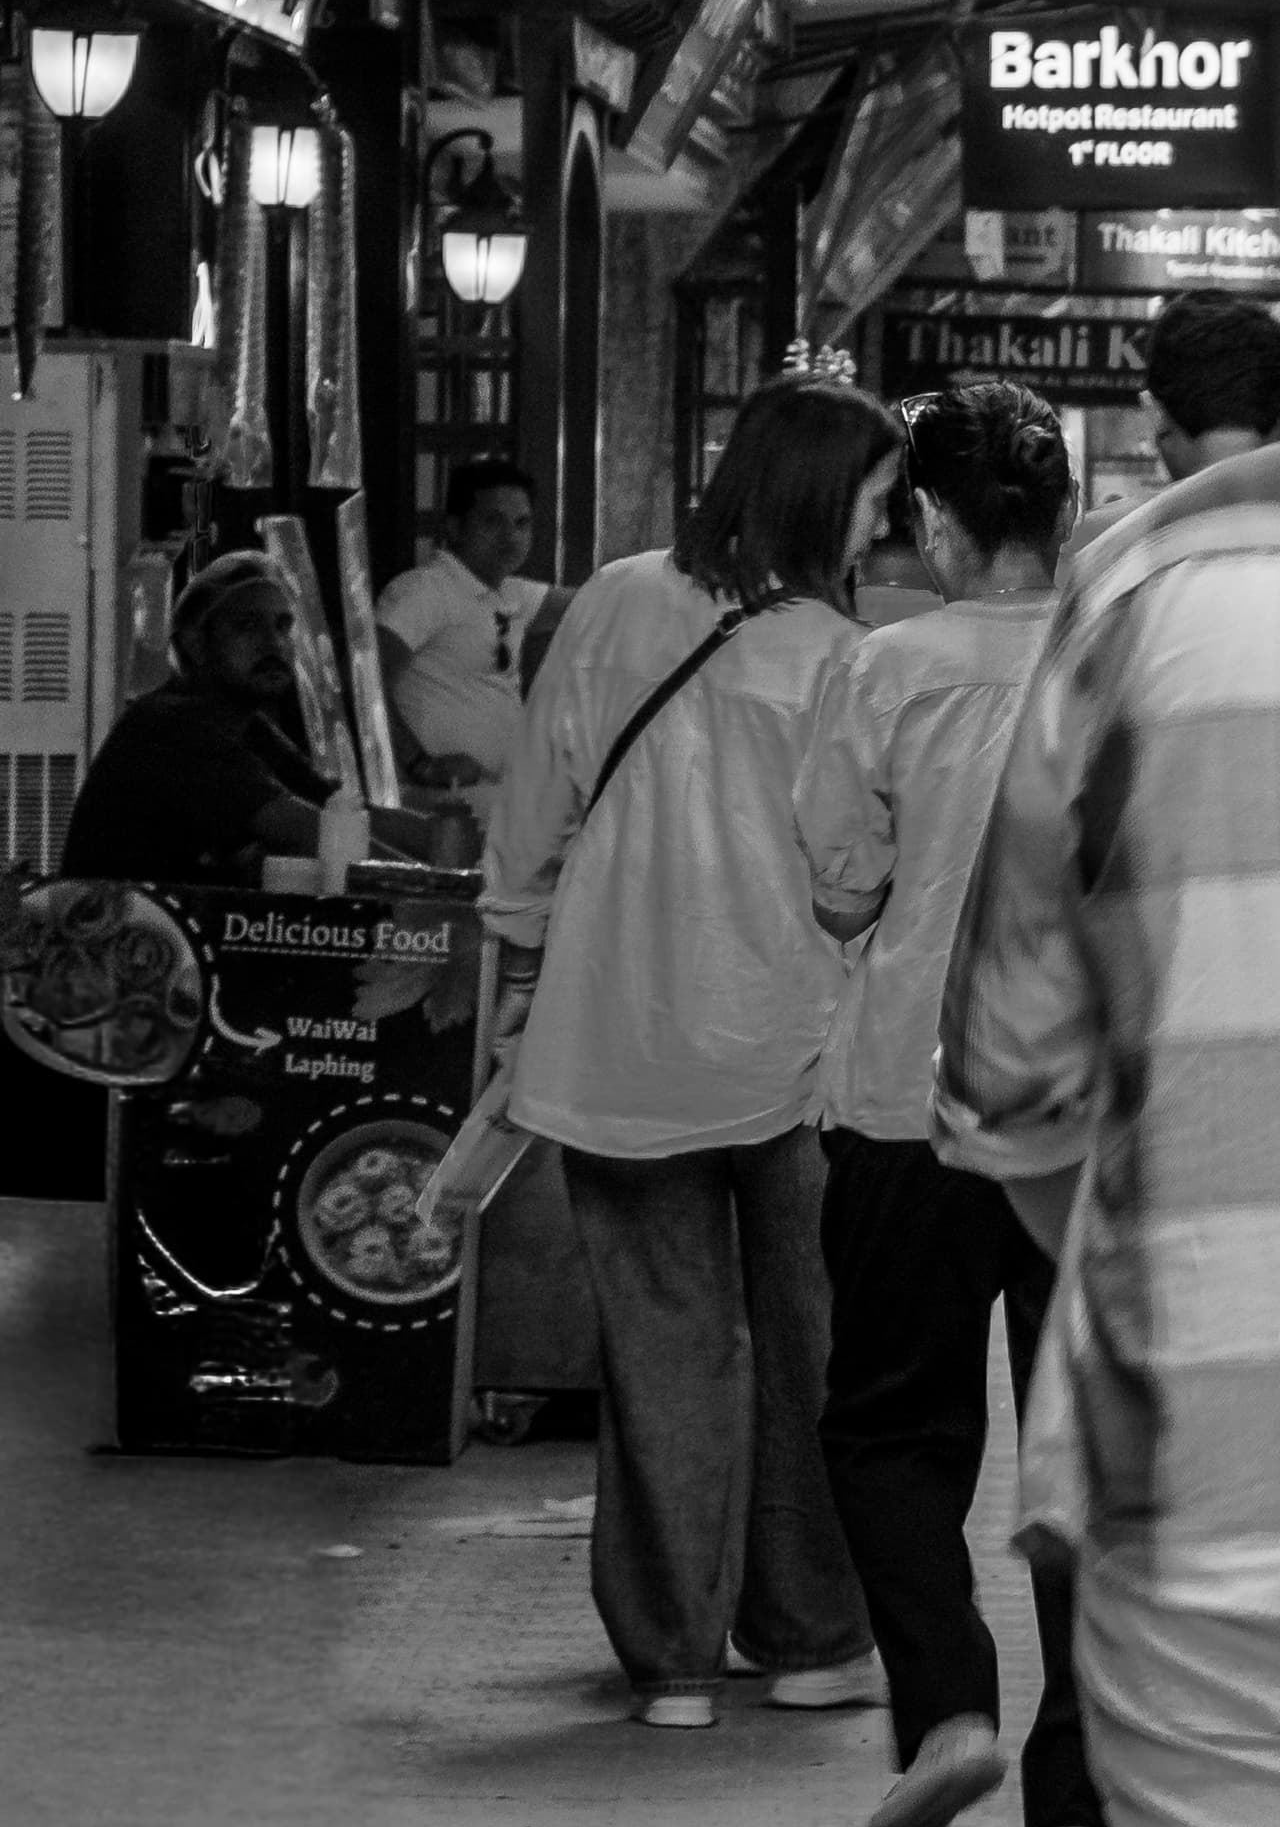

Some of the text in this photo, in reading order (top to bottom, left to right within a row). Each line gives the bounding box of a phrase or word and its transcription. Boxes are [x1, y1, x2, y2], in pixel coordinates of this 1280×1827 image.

[989, 25, 1253, 90] Barkhor
[1002, 103, 1238, 133] Hotpot Restaurant
[1094, 141, 1173, 166] FLOOR
[901, 320, 1091, 370] Thakali
[223, 910, 450, 954] Delicious Food
[285, 1015, 378, 1043] WaiWai
[284, 1052, 376, 1084] Laphing
